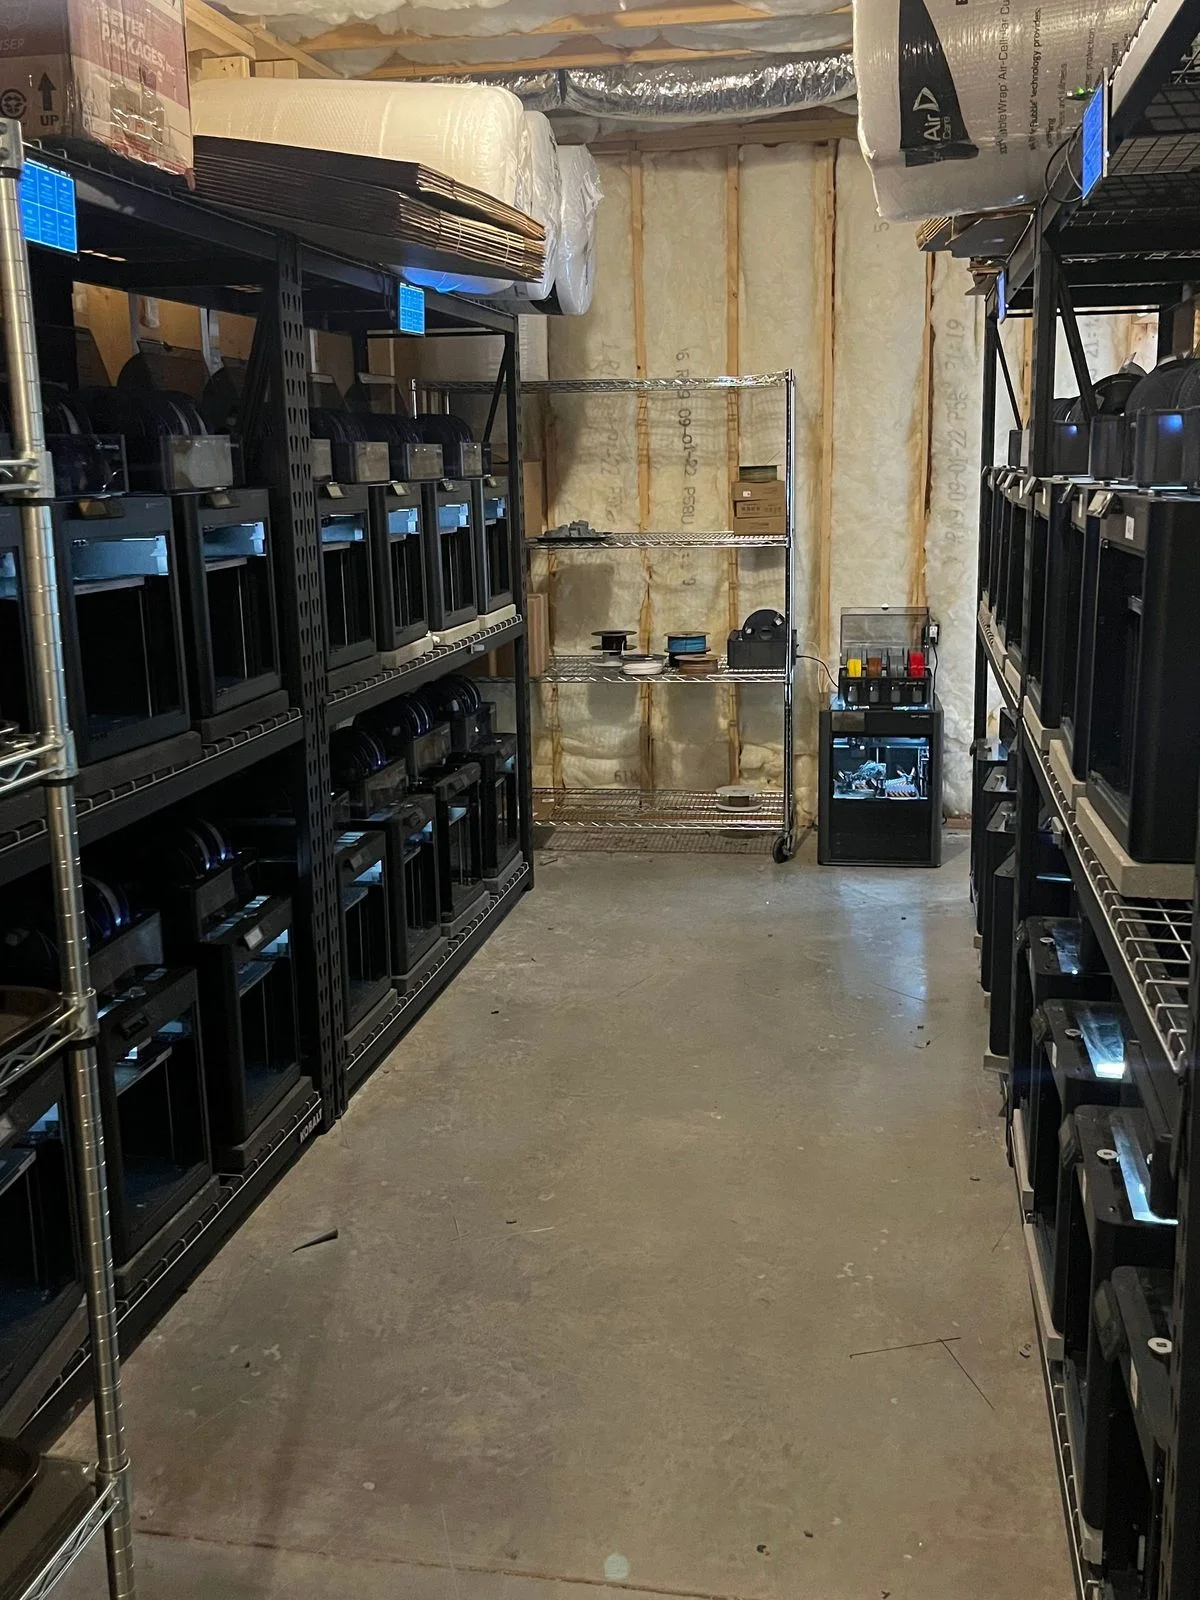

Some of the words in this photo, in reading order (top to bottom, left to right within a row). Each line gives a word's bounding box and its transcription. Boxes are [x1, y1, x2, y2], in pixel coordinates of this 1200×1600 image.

[101, 6, 146, 40] BETTER
[40, 114, 60, 127] UP
[923, 113, 941, 141] Air
[300, 1108, 322, 1144] KOBALT
